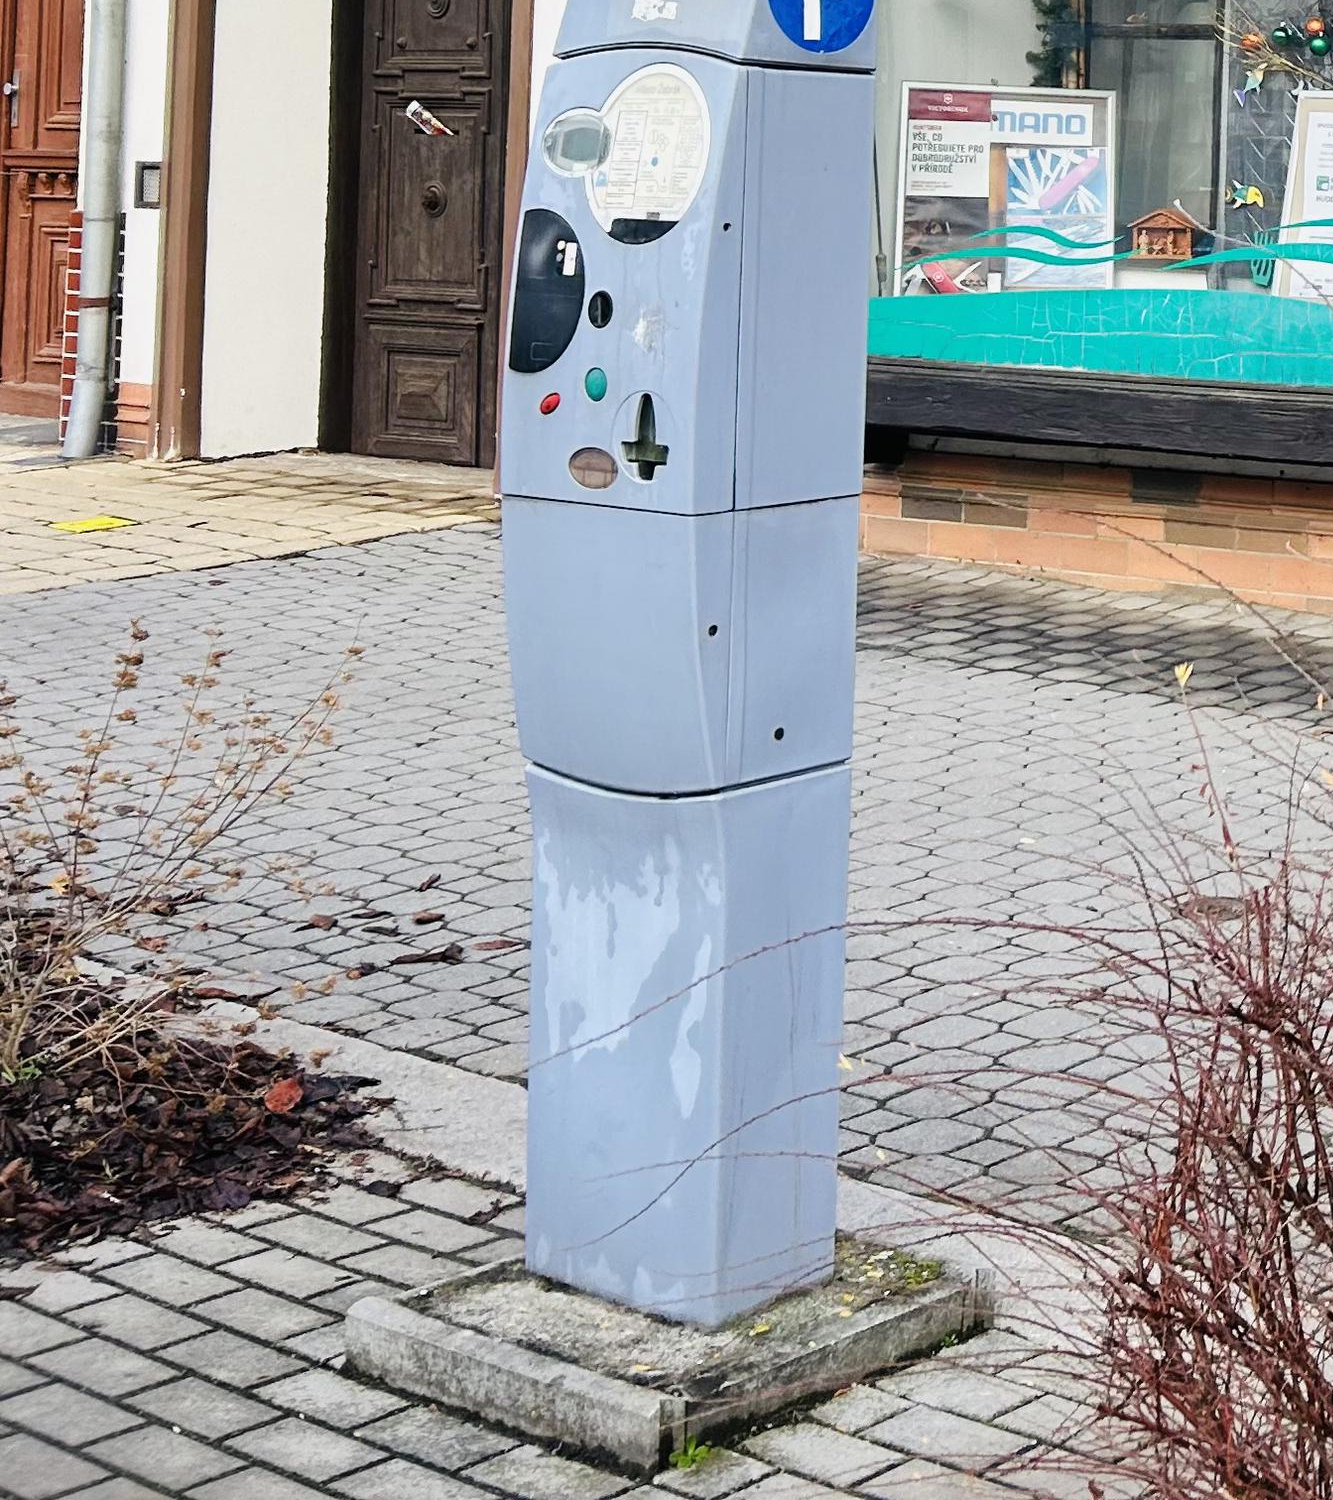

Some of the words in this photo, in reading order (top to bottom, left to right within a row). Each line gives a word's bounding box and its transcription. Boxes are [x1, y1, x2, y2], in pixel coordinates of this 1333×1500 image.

[932, 132, 943, 142] CO
[968, 144, 984, 153] PRO
[911, 163, 917, 172] V
